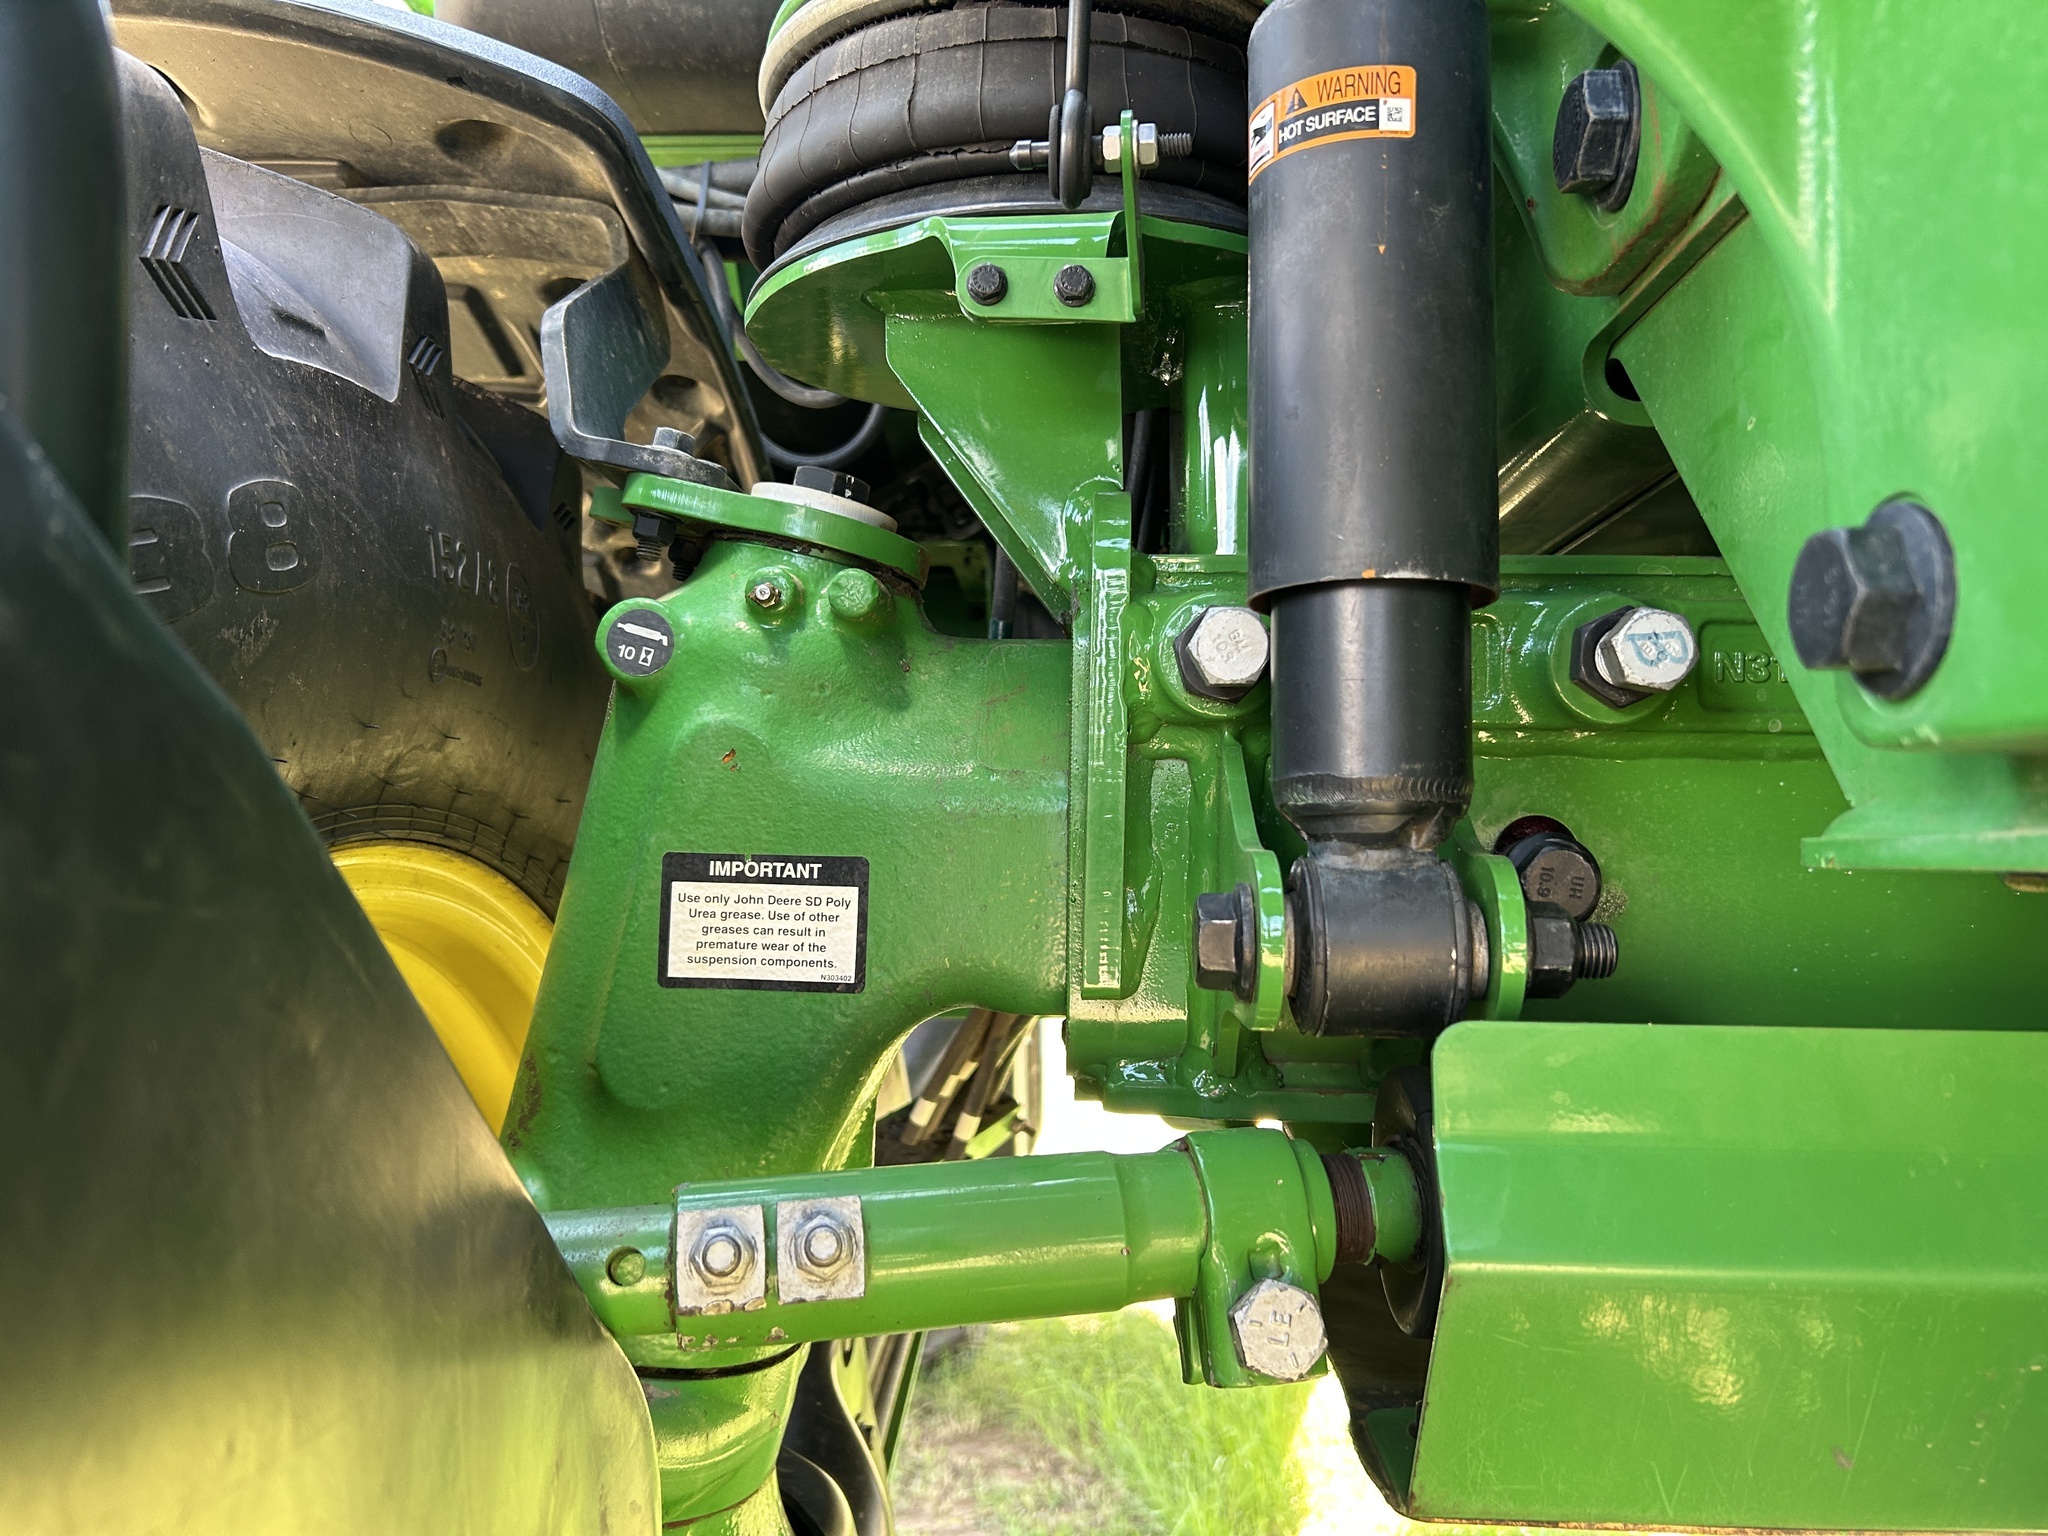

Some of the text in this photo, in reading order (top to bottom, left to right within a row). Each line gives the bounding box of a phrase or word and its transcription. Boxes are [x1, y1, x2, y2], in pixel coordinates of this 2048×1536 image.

[1316, 71, 1401, 103] WARNING
[1278, 106, 1377, 144] HOT SURFACE
[618, 644, 636, 660] 10
[709, 860, 822, 879] IMPORTANT
[1568, 876, 1585, 900] UH
[678, 893, 851, 909] Use only John Deere SD Poly
[689, 908, 839, 922] Urea grease. Use of other
[702, 926, 825, 937] greases can result in
[696, 940, 826, 952] premature wear of the
[687, 955, 837, 969] suspension components.
